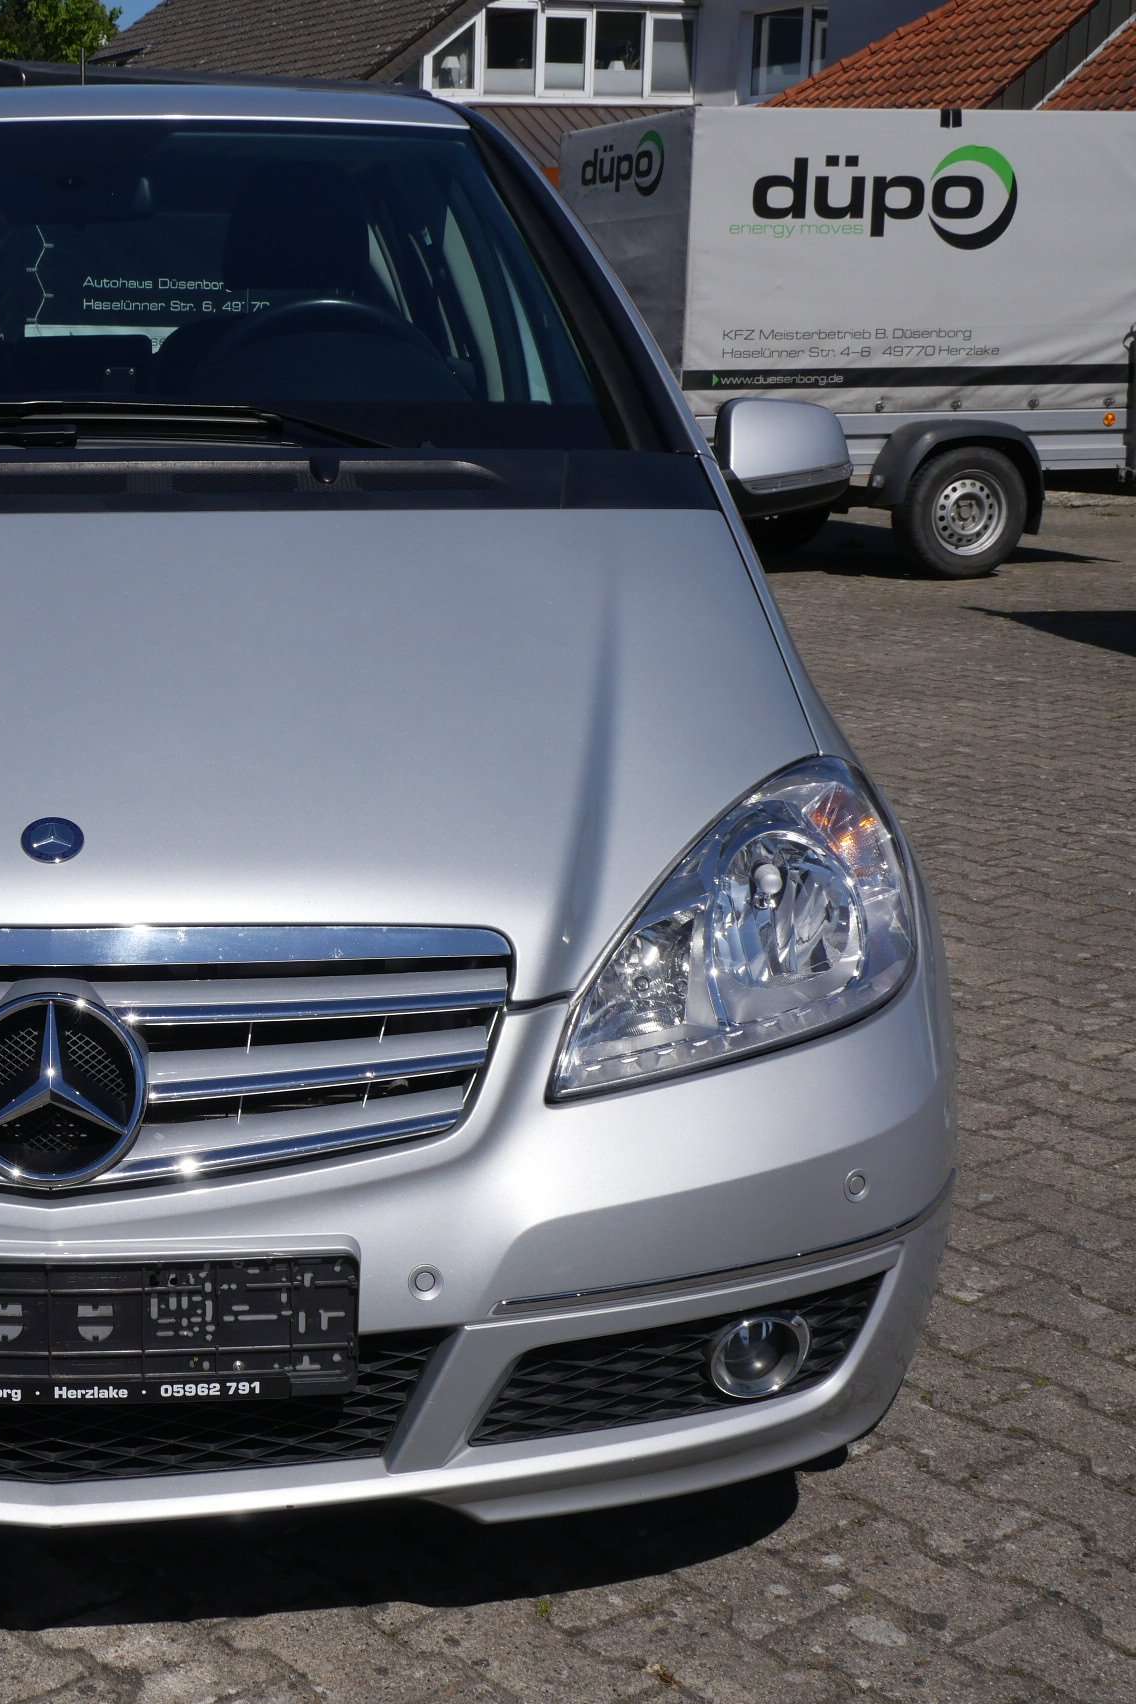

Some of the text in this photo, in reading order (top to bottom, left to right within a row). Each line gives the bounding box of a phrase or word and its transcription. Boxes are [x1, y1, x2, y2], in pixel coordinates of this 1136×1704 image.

[581, 144, 653, 193] düpo
[752, 154, 985, 237] düpo
[729, 222, 864, 238] energy moves
[83, 276, 232, 293] Autohaus Düsenbor
[83, 298, 166, 312] Haselünner
[170, 299, 197, 312] Str.
[202, 300, 216, 313] 6,
[722, 328, 972, 341] KFZ Meisterbetrieb B. Düsenborg
[722, 345, 1000, 359] Haselünner Str. 4-6 49770 Herzlake
[721, 374, 844, 386] www.duesenborg.de
[54, 1385, 129, 1399] Herzlake
[160, 1382, 221, 1398] 05962
[225, 1381, 261, 1396] 791
